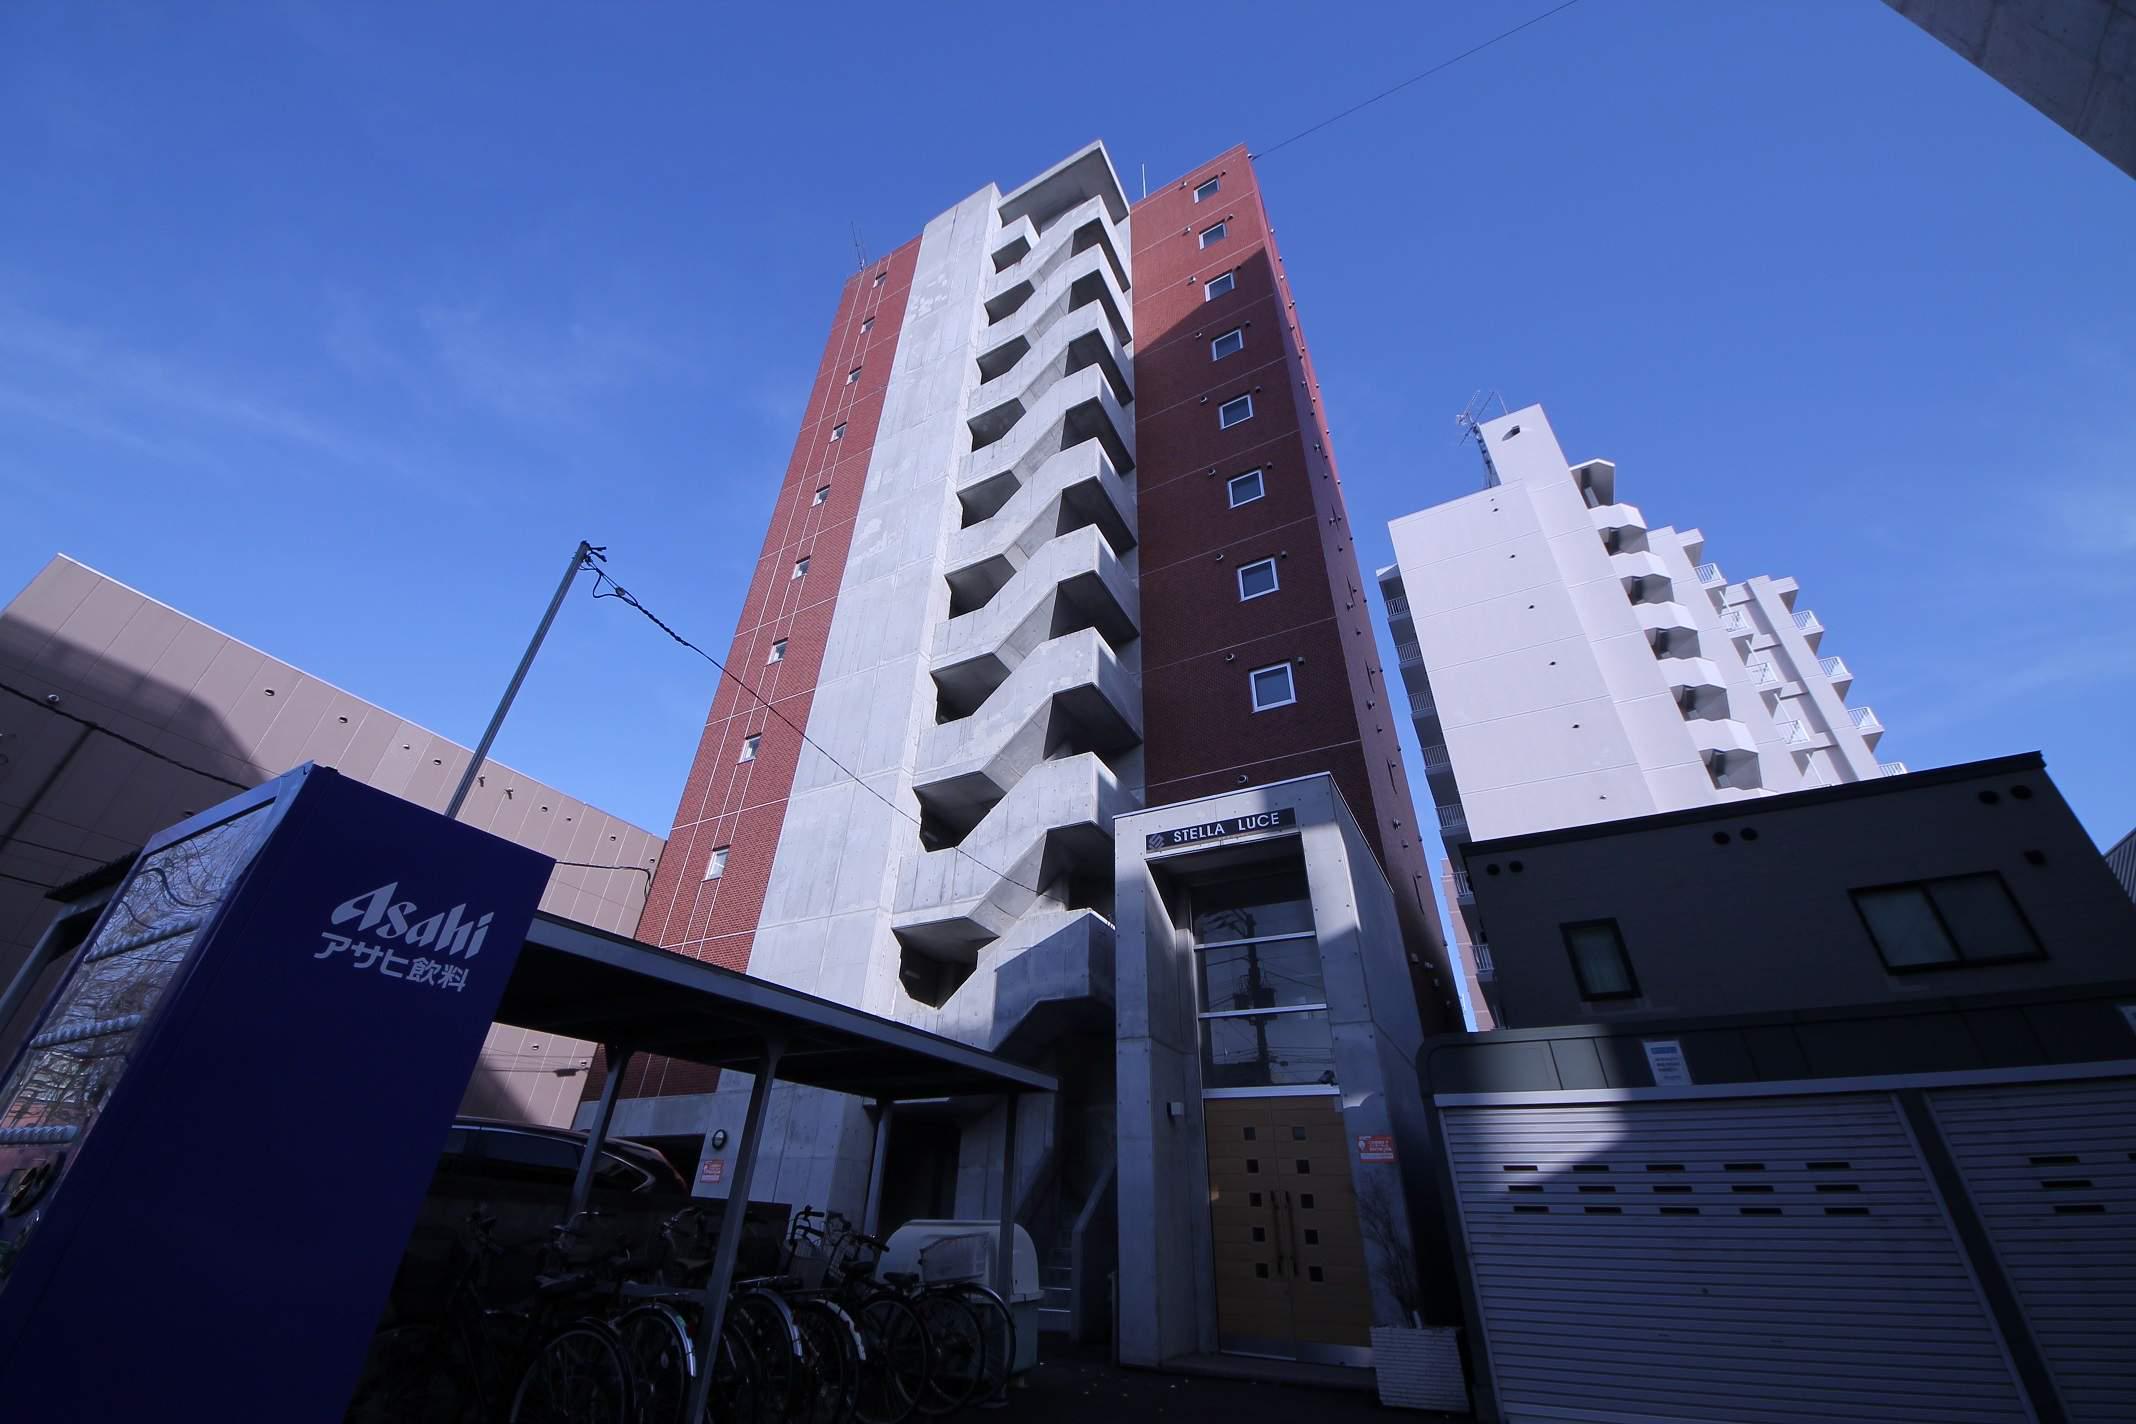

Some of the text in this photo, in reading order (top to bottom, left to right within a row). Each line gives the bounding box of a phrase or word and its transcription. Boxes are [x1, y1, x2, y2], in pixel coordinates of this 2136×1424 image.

[1173, 812, 1280, 843] STELLA LUCE
[331, 881, 495, 960] Asahi
[313, 932, 469, 992] アサヒ飲料
